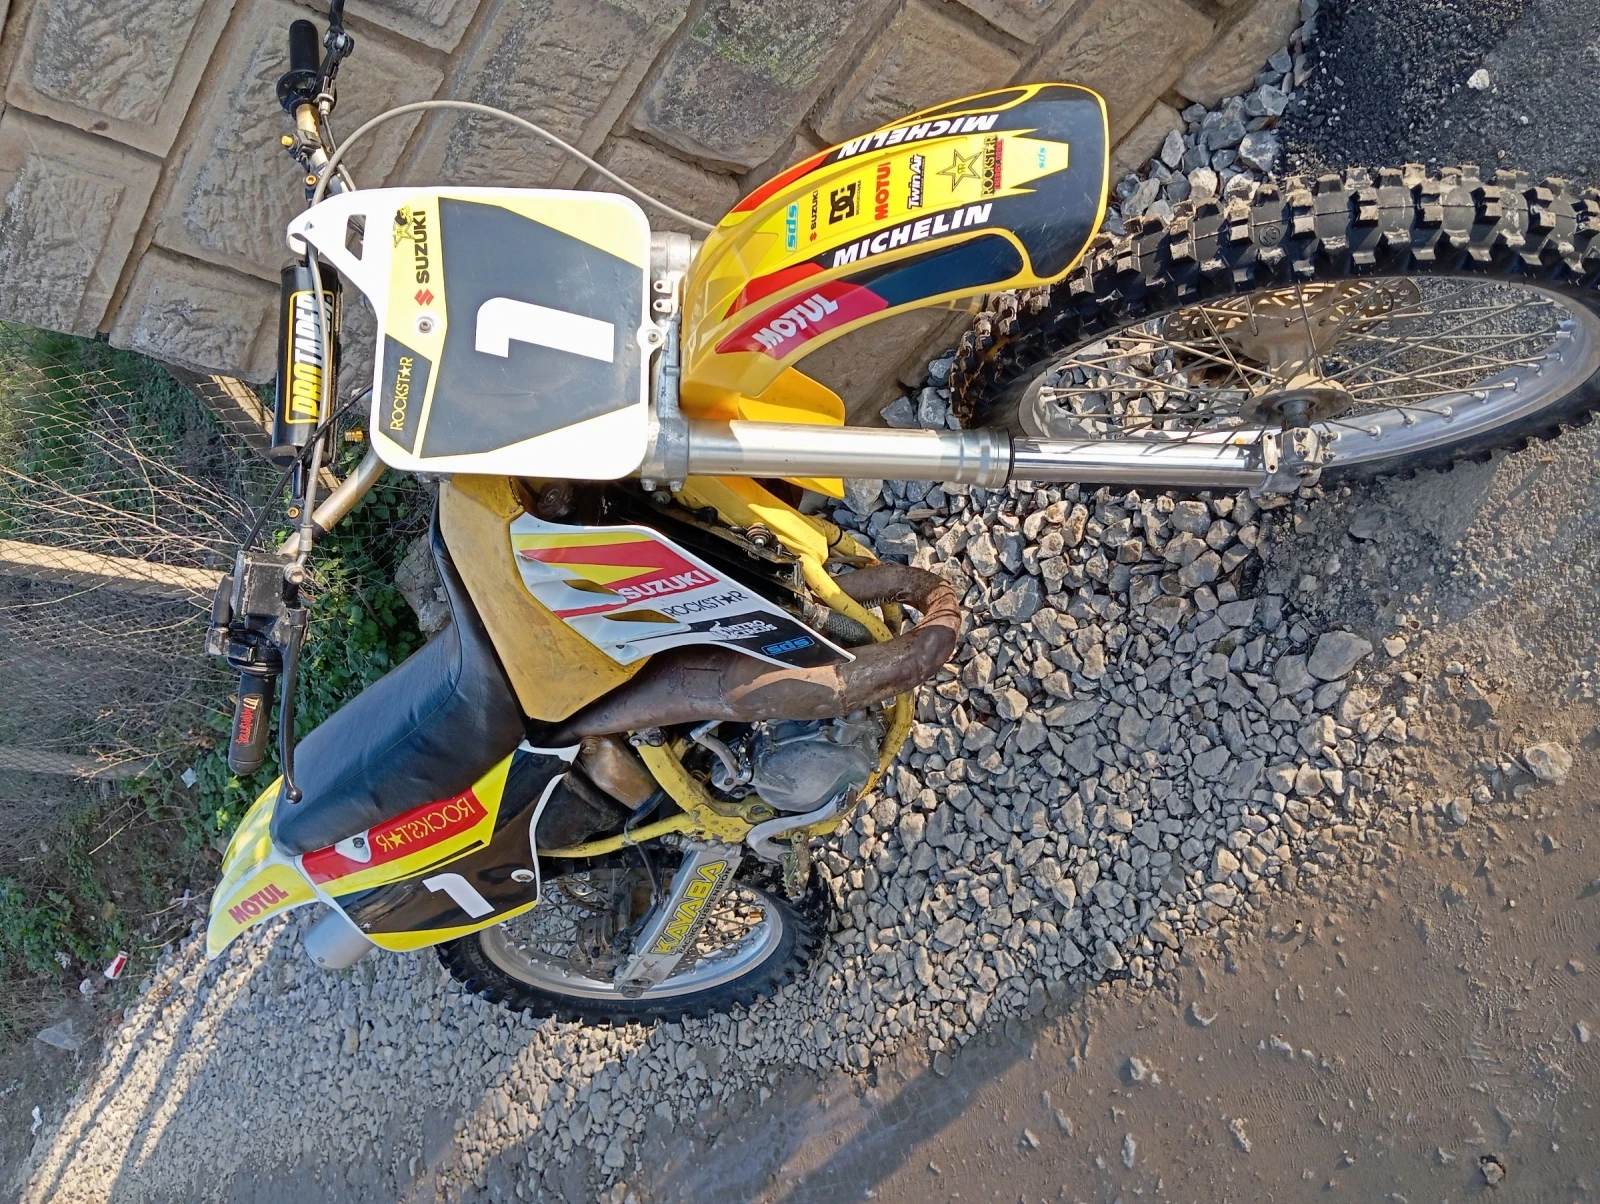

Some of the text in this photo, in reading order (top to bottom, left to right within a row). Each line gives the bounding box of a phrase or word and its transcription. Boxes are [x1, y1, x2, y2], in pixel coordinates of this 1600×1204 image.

[837, 114, 999, 160] MICHELIN
[908, 154, 922, 209] Twin Air
[415, 210, 430, 284] SUZUKI
[787, 204, 798, 249] sds
[832, 203, 992, 268] MICHELIN
[475, 297, 614, 363] 1
[751, 293, 838, 350] MOTUL
[622, 570, 711, 600] SUZUKI
[766, 638, 810, 654] sds
[228, 884, 289, 925] MOTUL
[422, 873, 495, 919] 1
[651, 860, 728, 955] KAYABA
[677, 867, 732, 954] RACING SUSPENSION
